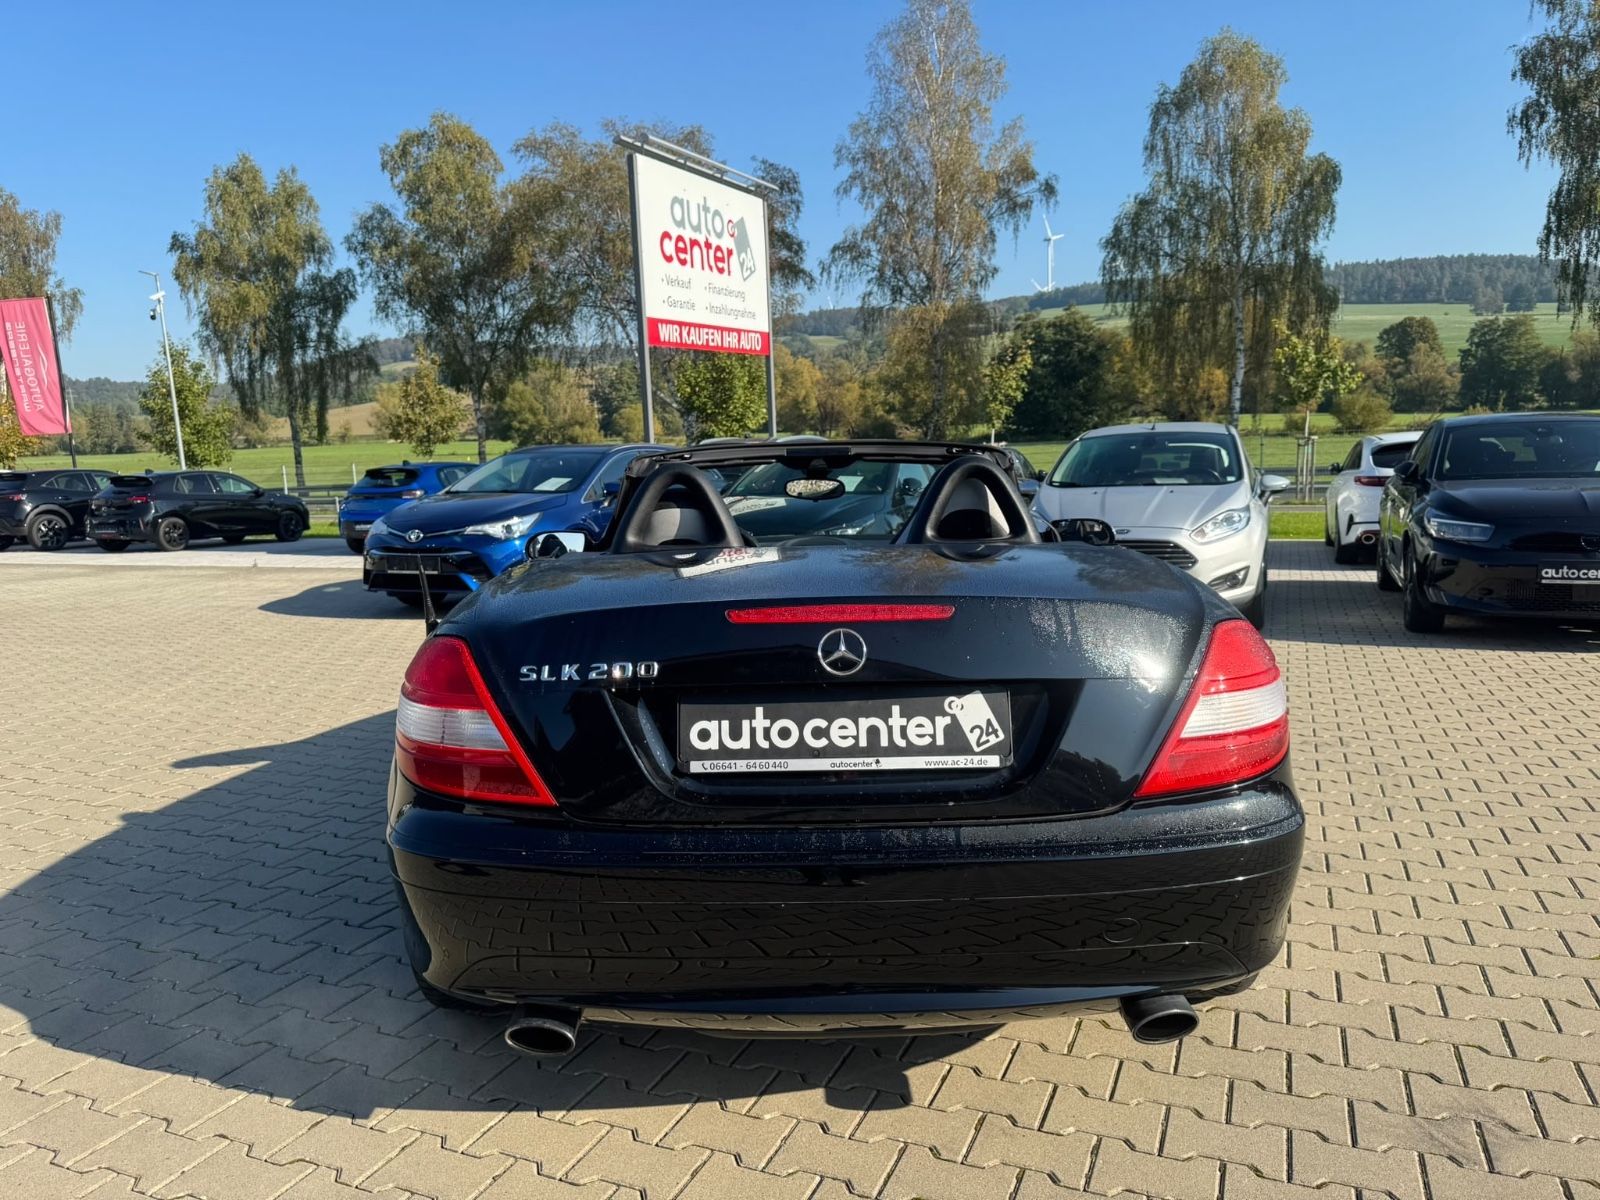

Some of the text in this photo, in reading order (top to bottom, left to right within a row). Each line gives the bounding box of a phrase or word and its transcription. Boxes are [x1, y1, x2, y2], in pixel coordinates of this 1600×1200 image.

[670, 196, 724, 239] auto
[659, 230, 734, 276] center
[739, 247, 755, 277] 24
[664, 273, 692, 289] Verkauf
[708, 282, 746, 302] Finanzierung
[667, 295, 696, 311] Garantie
[709, 302, 756, 320] Inzahlungnahme
[657, 322, 762, 351] WIR KAUFEN IHR AUTO
[519, 661, 659, 681] SLK 200
[969, 718, 1000, 749] 24
[709, 761, 737, 771] 06641
[830, 760, 874, 769] autocenter
[924, 758, 989, 767] www.ac-24.de
